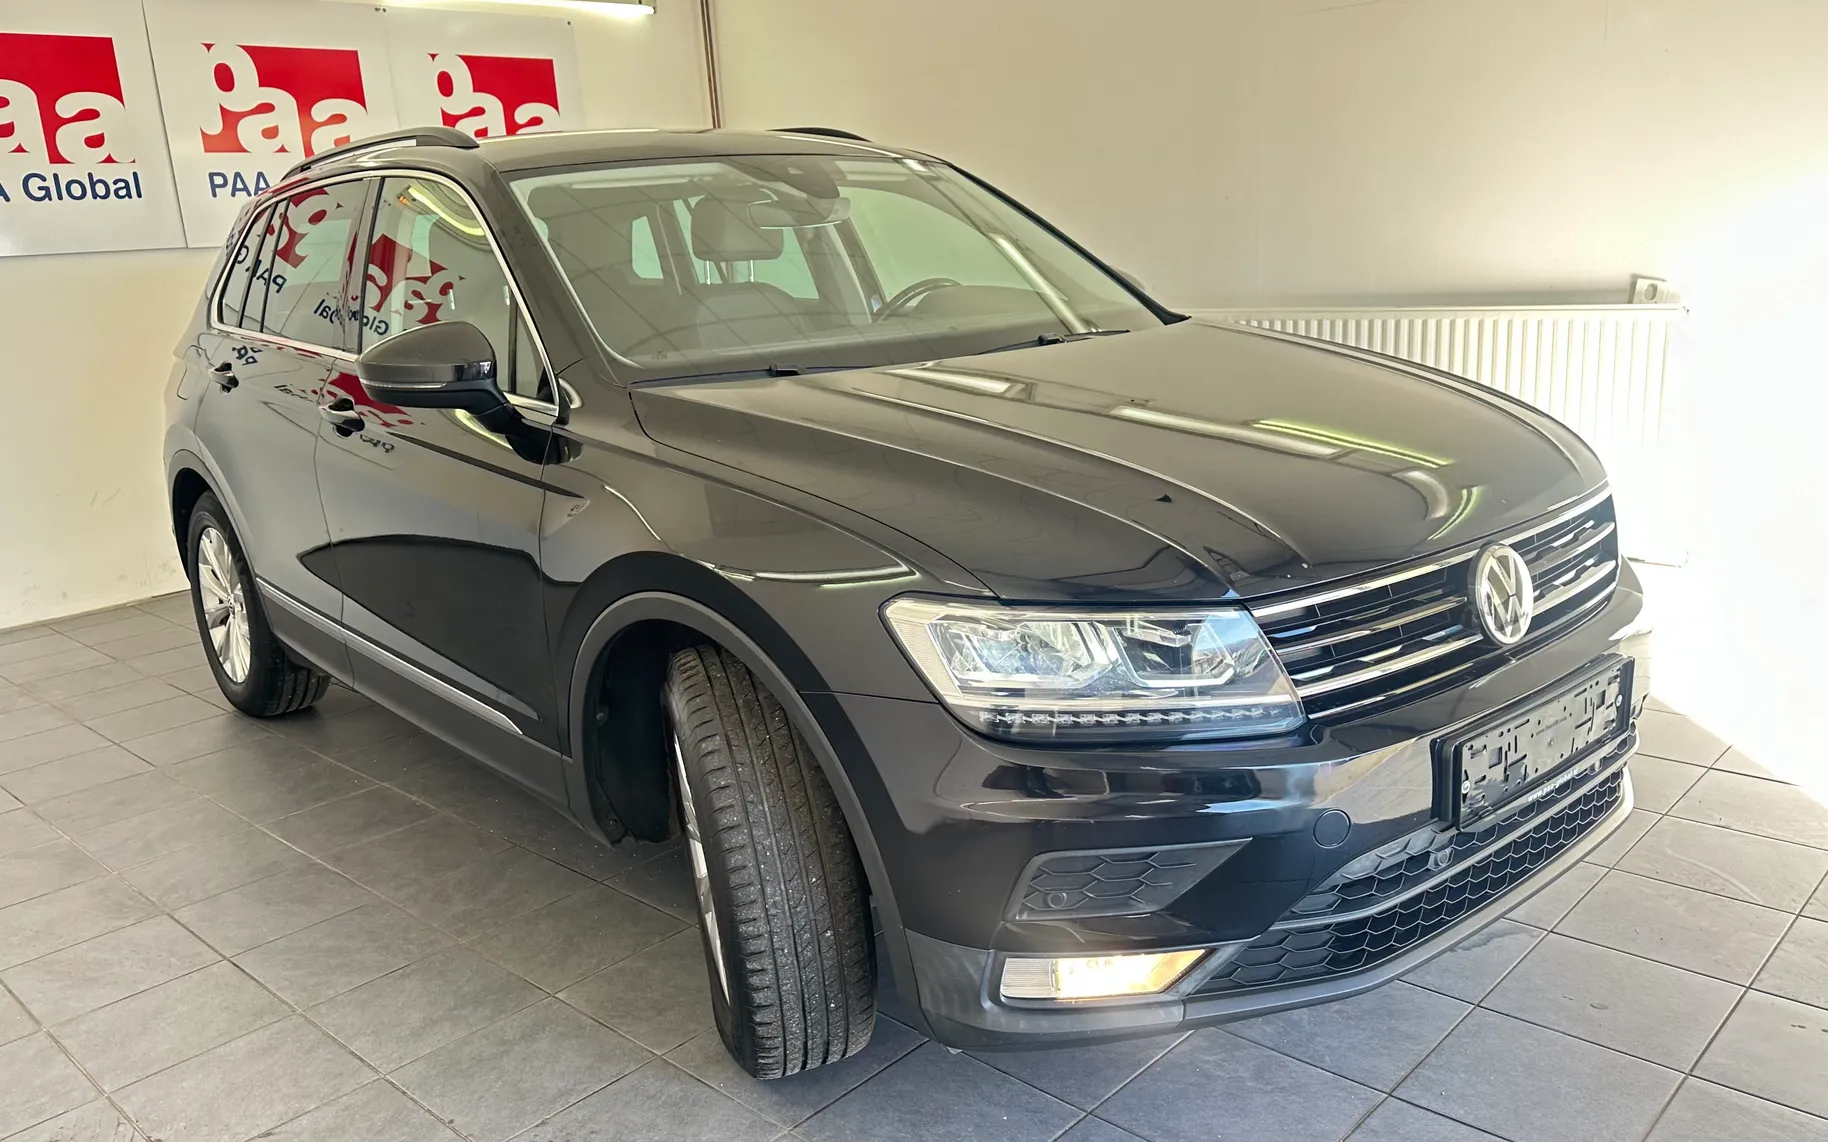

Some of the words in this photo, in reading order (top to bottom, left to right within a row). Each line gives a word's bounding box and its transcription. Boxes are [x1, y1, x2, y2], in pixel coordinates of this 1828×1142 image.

[0, 78, 136, 164] aa
[22, 171, 143, 202] Global
[208, 171, 271, 198] PAA
